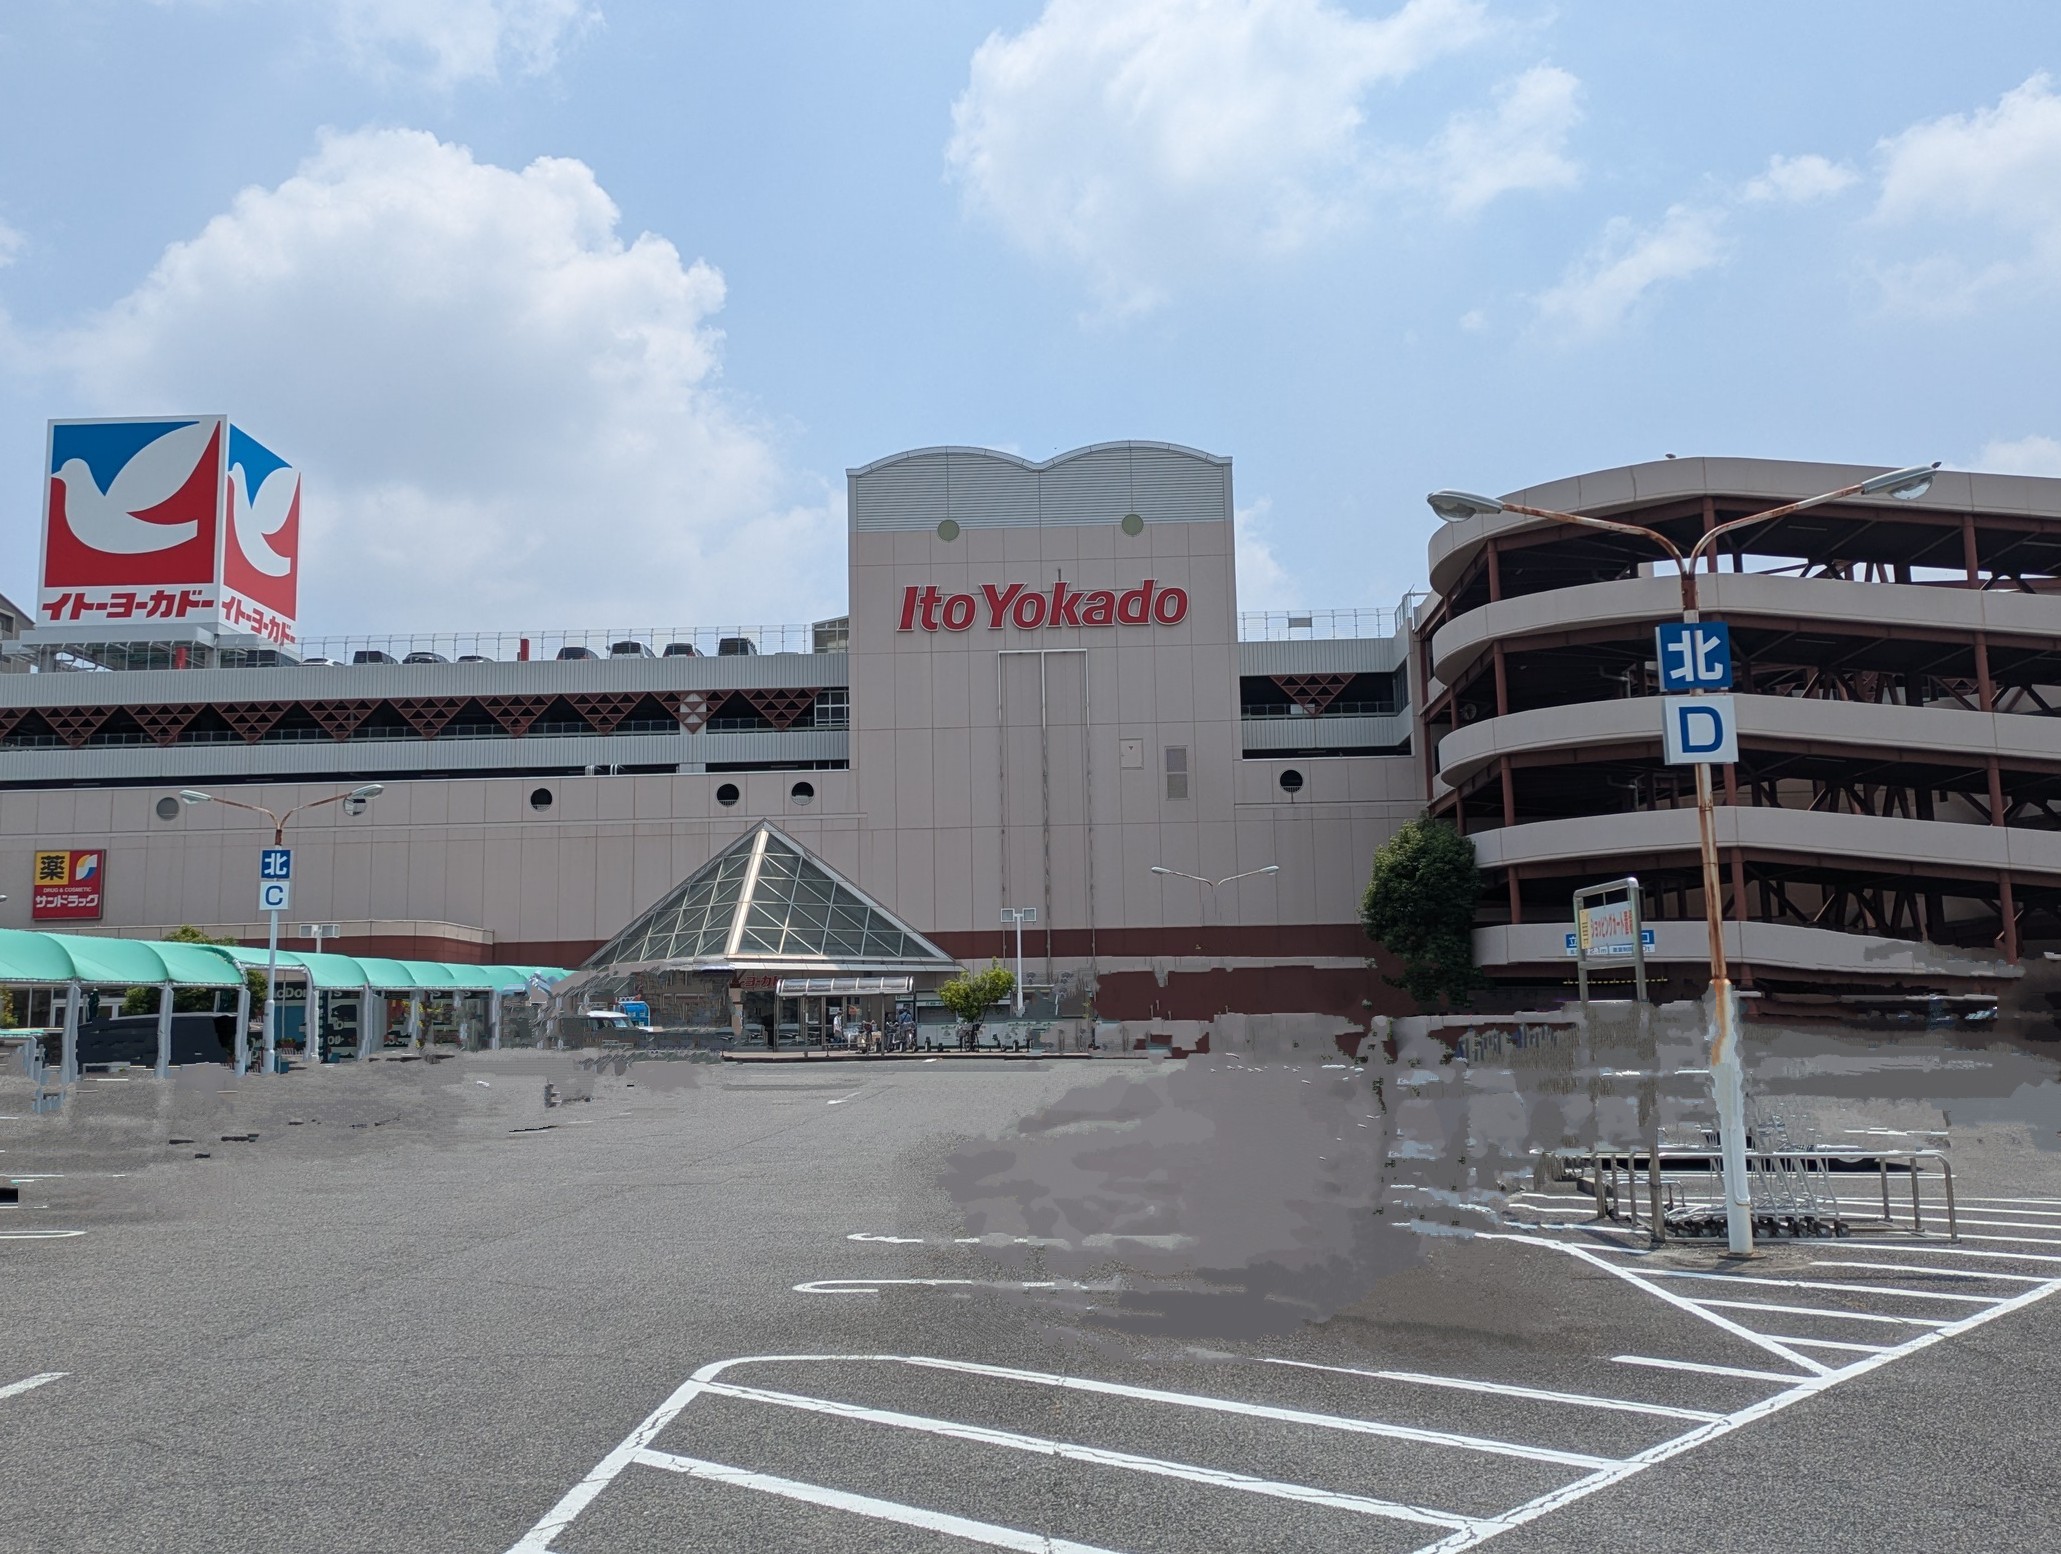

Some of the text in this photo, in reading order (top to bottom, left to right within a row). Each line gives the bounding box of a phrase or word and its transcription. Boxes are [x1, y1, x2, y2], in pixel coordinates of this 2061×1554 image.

[42, 590, 215, 621] イトーヨーカドー
[221, 595, 296, 644] イトーヨーカドー
[1667, 629, 1724, 682] 北
[1678, 706, 1724, 754] D
[39, 855, 66, 881] 薬
[264, 852, 288, 876] 北
[265, 885, 284, 906] C
